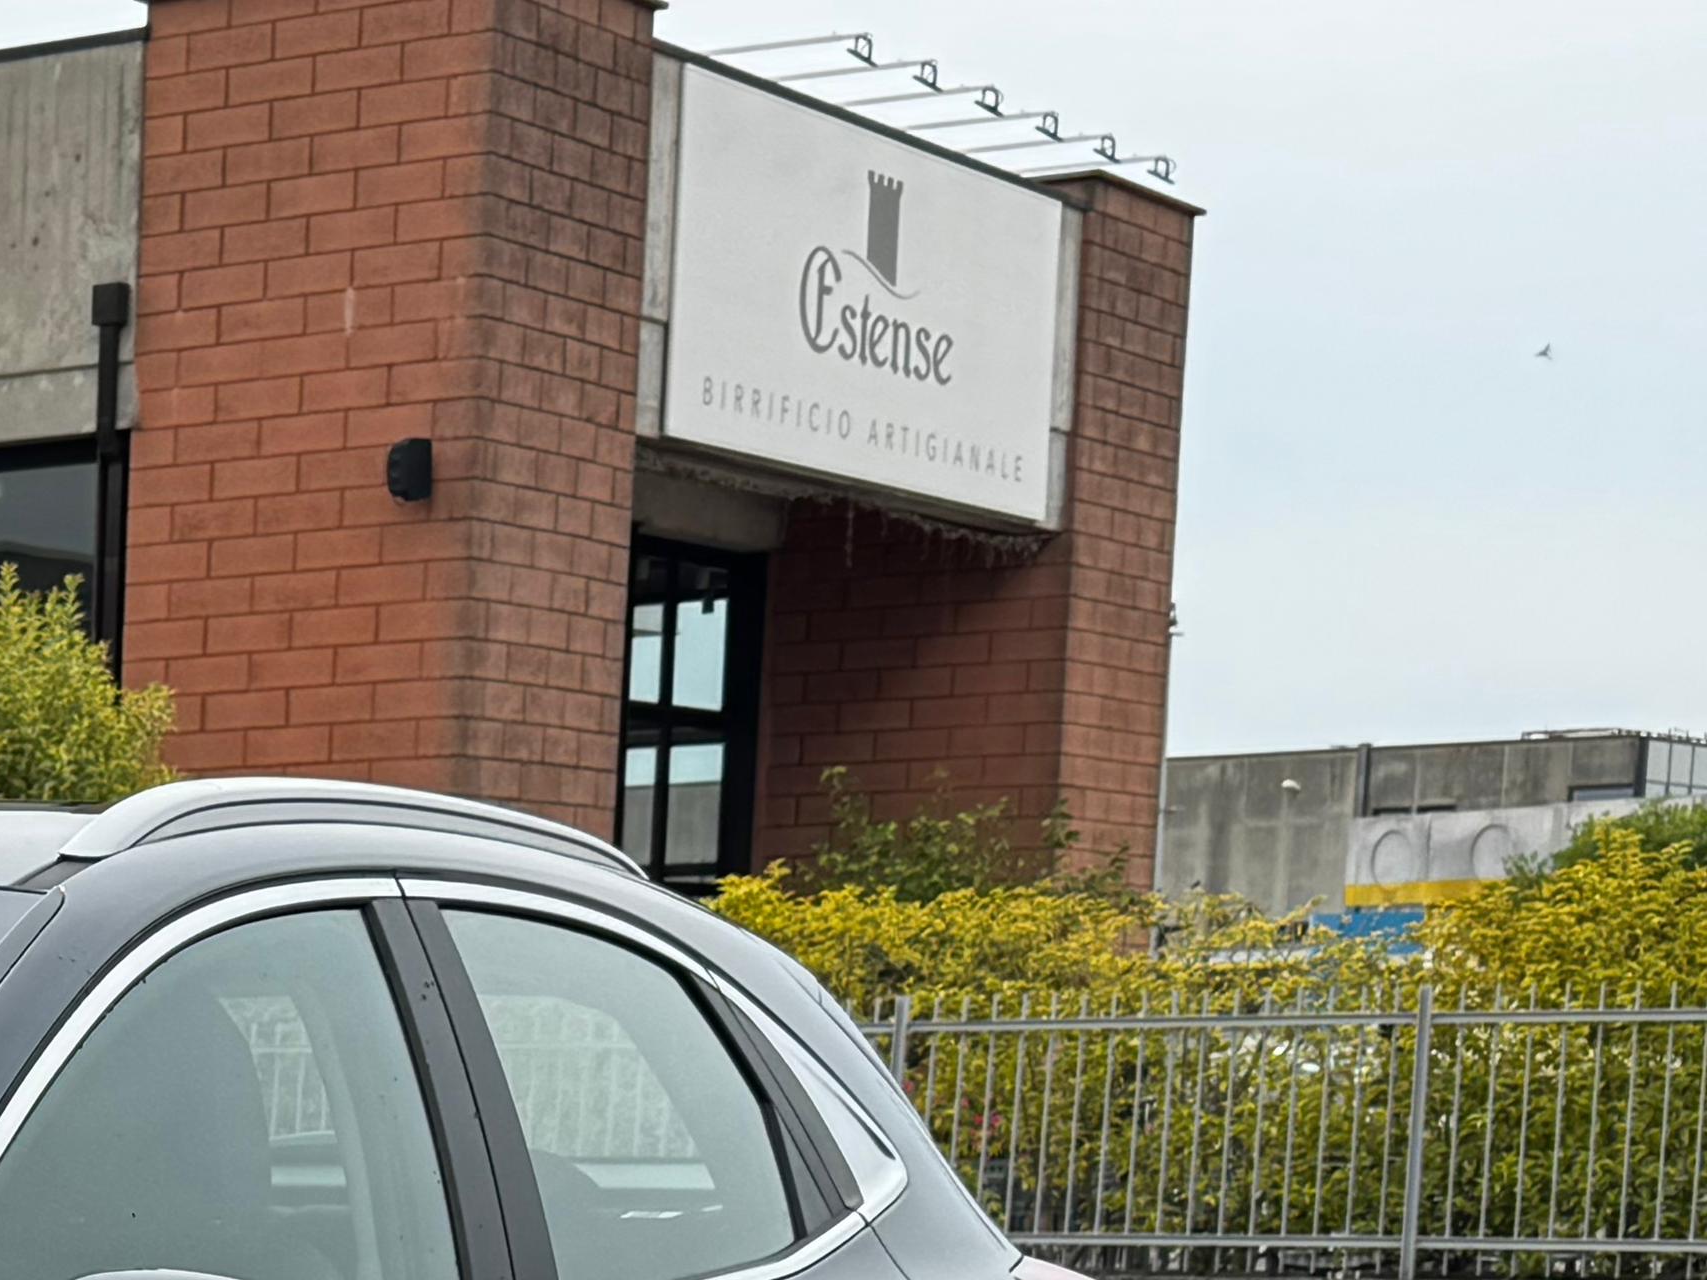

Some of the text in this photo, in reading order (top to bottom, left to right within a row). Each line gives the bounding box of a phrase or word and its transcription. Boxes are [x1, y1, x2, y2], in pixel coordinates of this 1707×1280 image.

[799, 245, 954, 386] Estense
[702, 375, 1024, 483] BIRRIFICIO ARTIGIANALE
